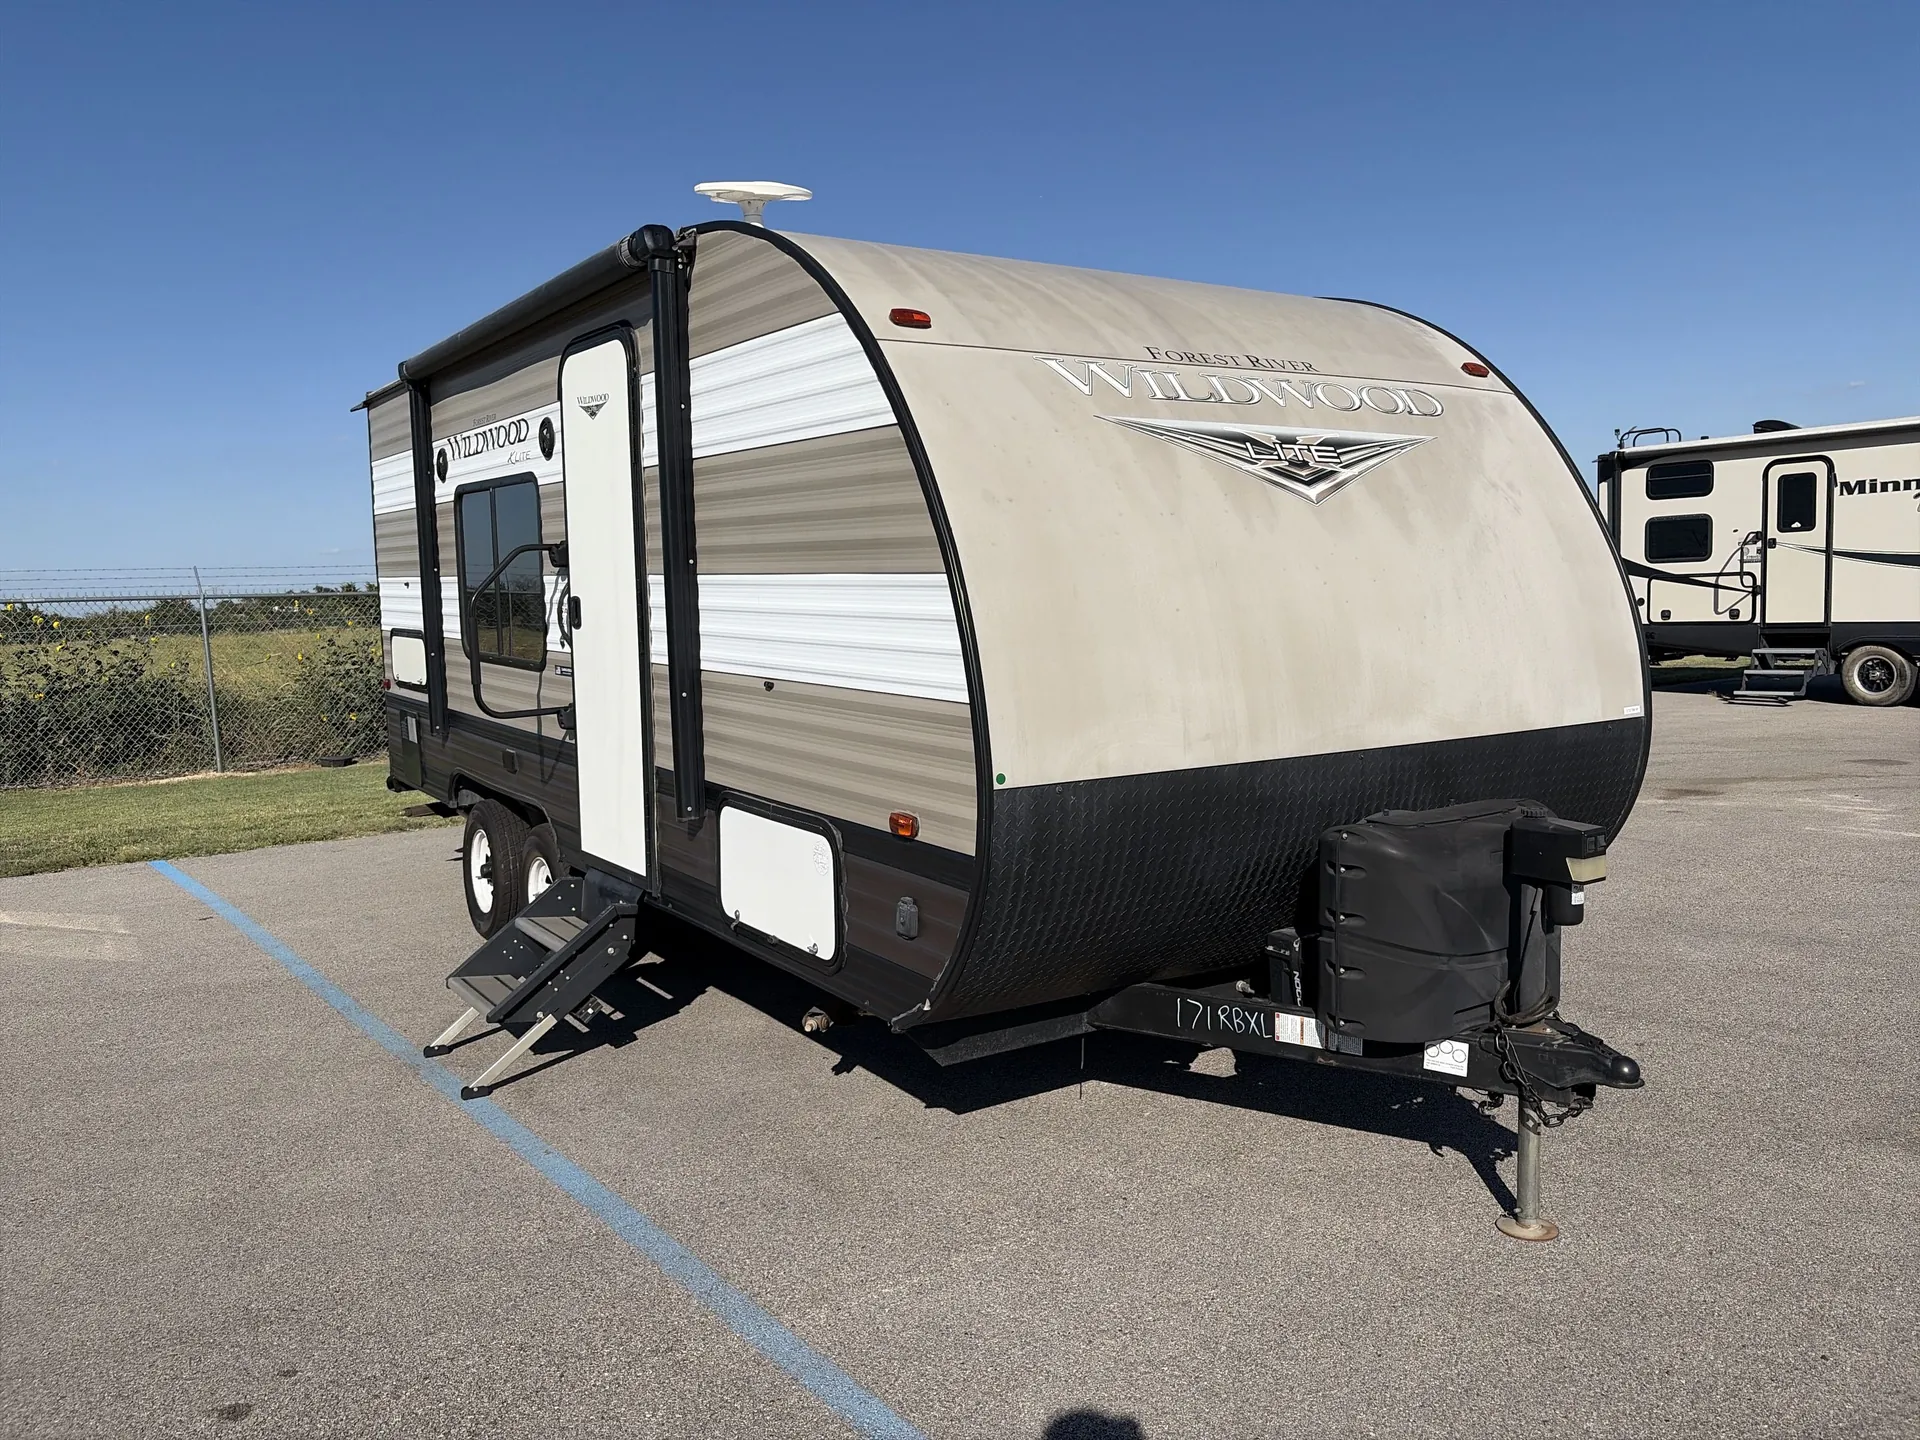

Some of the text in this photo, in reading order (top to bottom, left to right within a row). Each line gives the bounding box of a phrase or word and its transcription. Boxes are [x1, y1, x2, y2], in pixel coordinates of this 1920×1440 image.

[1143, 345, 1321, 373] FOREST RIVER
[576, 393, 610, 405] WILDWOOD
[1031, 356, 1445, 418] WILDWOOD
[447, 418, 530, 461] WILDWOOD
[1245, 441, 1342, 464] LITE
[1838, 478, 1920, 497] Minn
[1176, 997, 1273, 1039] 171RBXL
